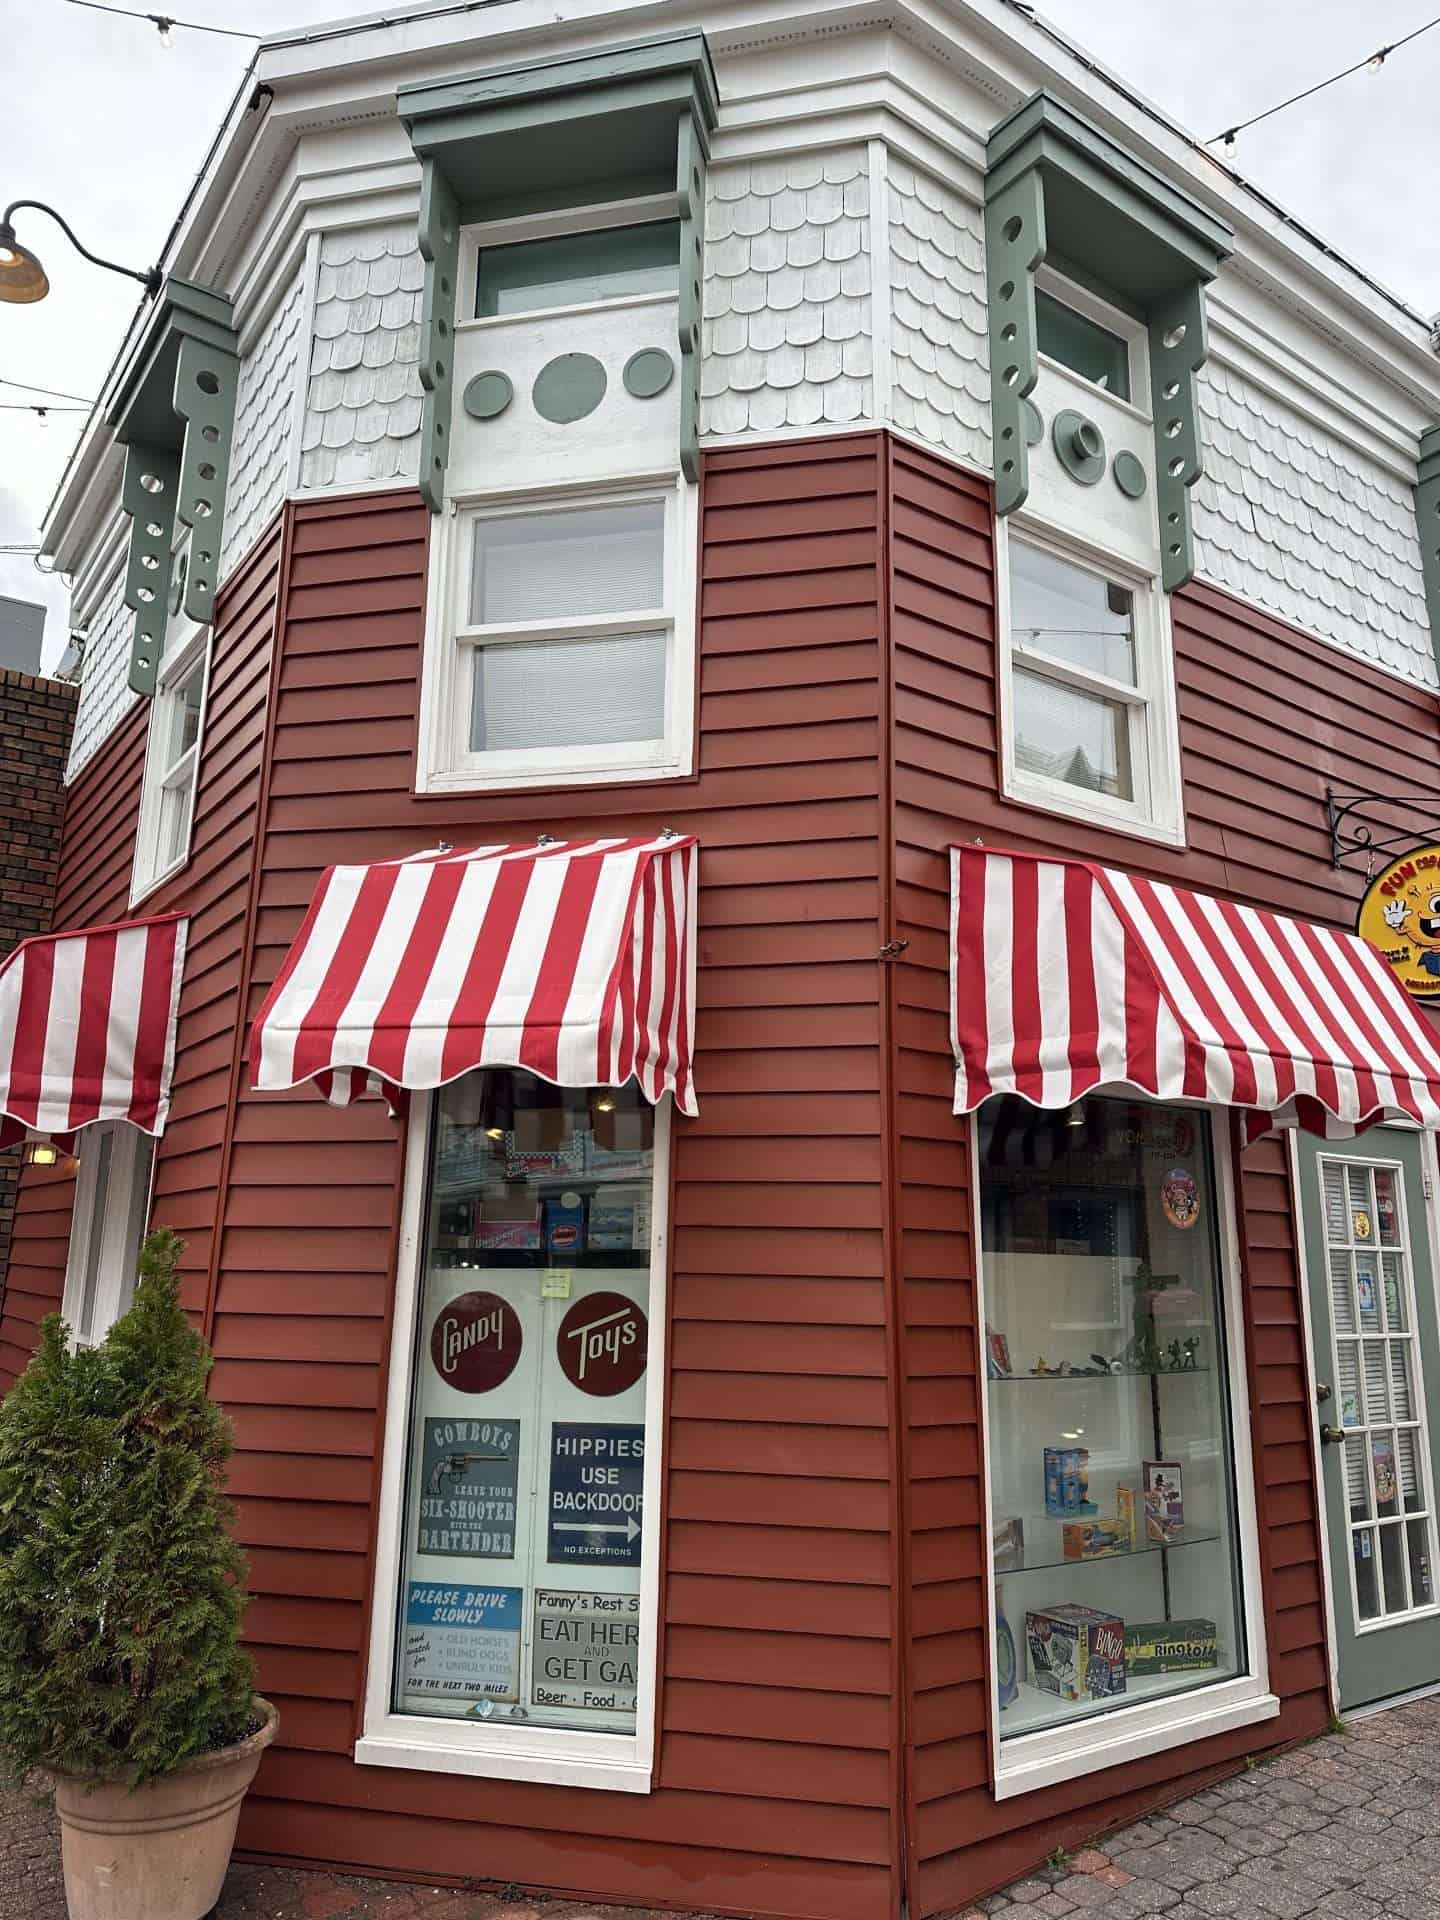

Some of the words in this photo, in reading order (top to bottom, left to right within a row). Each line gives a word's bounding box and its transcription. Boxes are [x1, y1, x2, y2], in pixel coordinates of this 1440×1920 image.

[433, 1422, 513, 1450] COWBOYS
[556, 1438, 645, 1457] HIPPIES
[581, 1467, 619, 1485] USE
[455, 1485, 485, 1496] LEAVE
[488, 1486, 513, 1497] YOUR
[422, 1499, 514, 1521] SIX-SHOOTER
[420, 1529, 512, 1553] BARTENDER
[564, 1546, 576, 1554] NO
[578, 1546, 632, 1556] EXCEPTIONS
[411, 1589, 460, 1606] PLEASE
[464, 1592, 507, 1608] DRIVE
[538, 1592, 588, 1612] Fanny's
[593, 1596, 624, 1611] Rest
[432, 1607, 484, 1624] SLOWLY
[540, 1618, 584, 1641] EAT
[584, 1646, 610, 1657] AND
[544, 1656, 592, 1681] GET
[407, 1678, 422, 1687] FOR
[425, 1679, 440, 1688] THE
[442, 1680, 462, 1690] NEXT
[464, 1682, 481, 1692] TWO
[483, 1683, 510, 1694] MILES
[536, 1687, 567, 1703] Beer
[583, 1691, 616, 1707] Food
